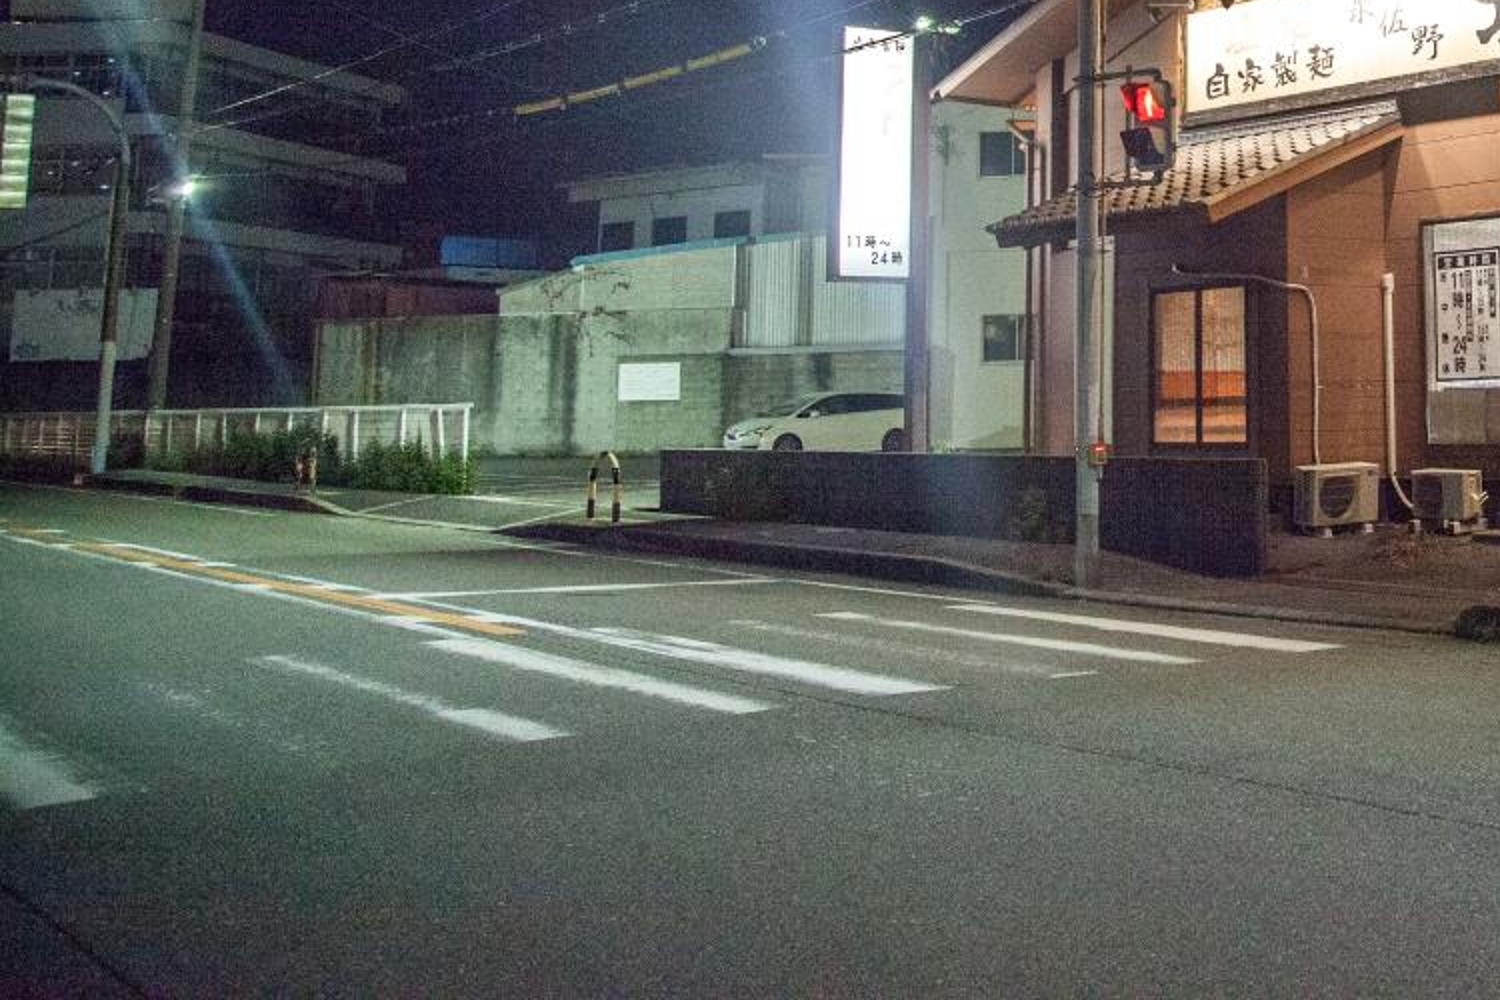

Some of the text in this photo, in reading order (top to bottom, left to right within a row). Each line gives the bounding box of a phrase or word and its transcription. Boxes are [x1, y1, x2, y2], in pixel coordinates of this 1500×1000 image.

[1205, 42, 1335, 101] 自家製麺
[871, 251, 903, 265] 24時
